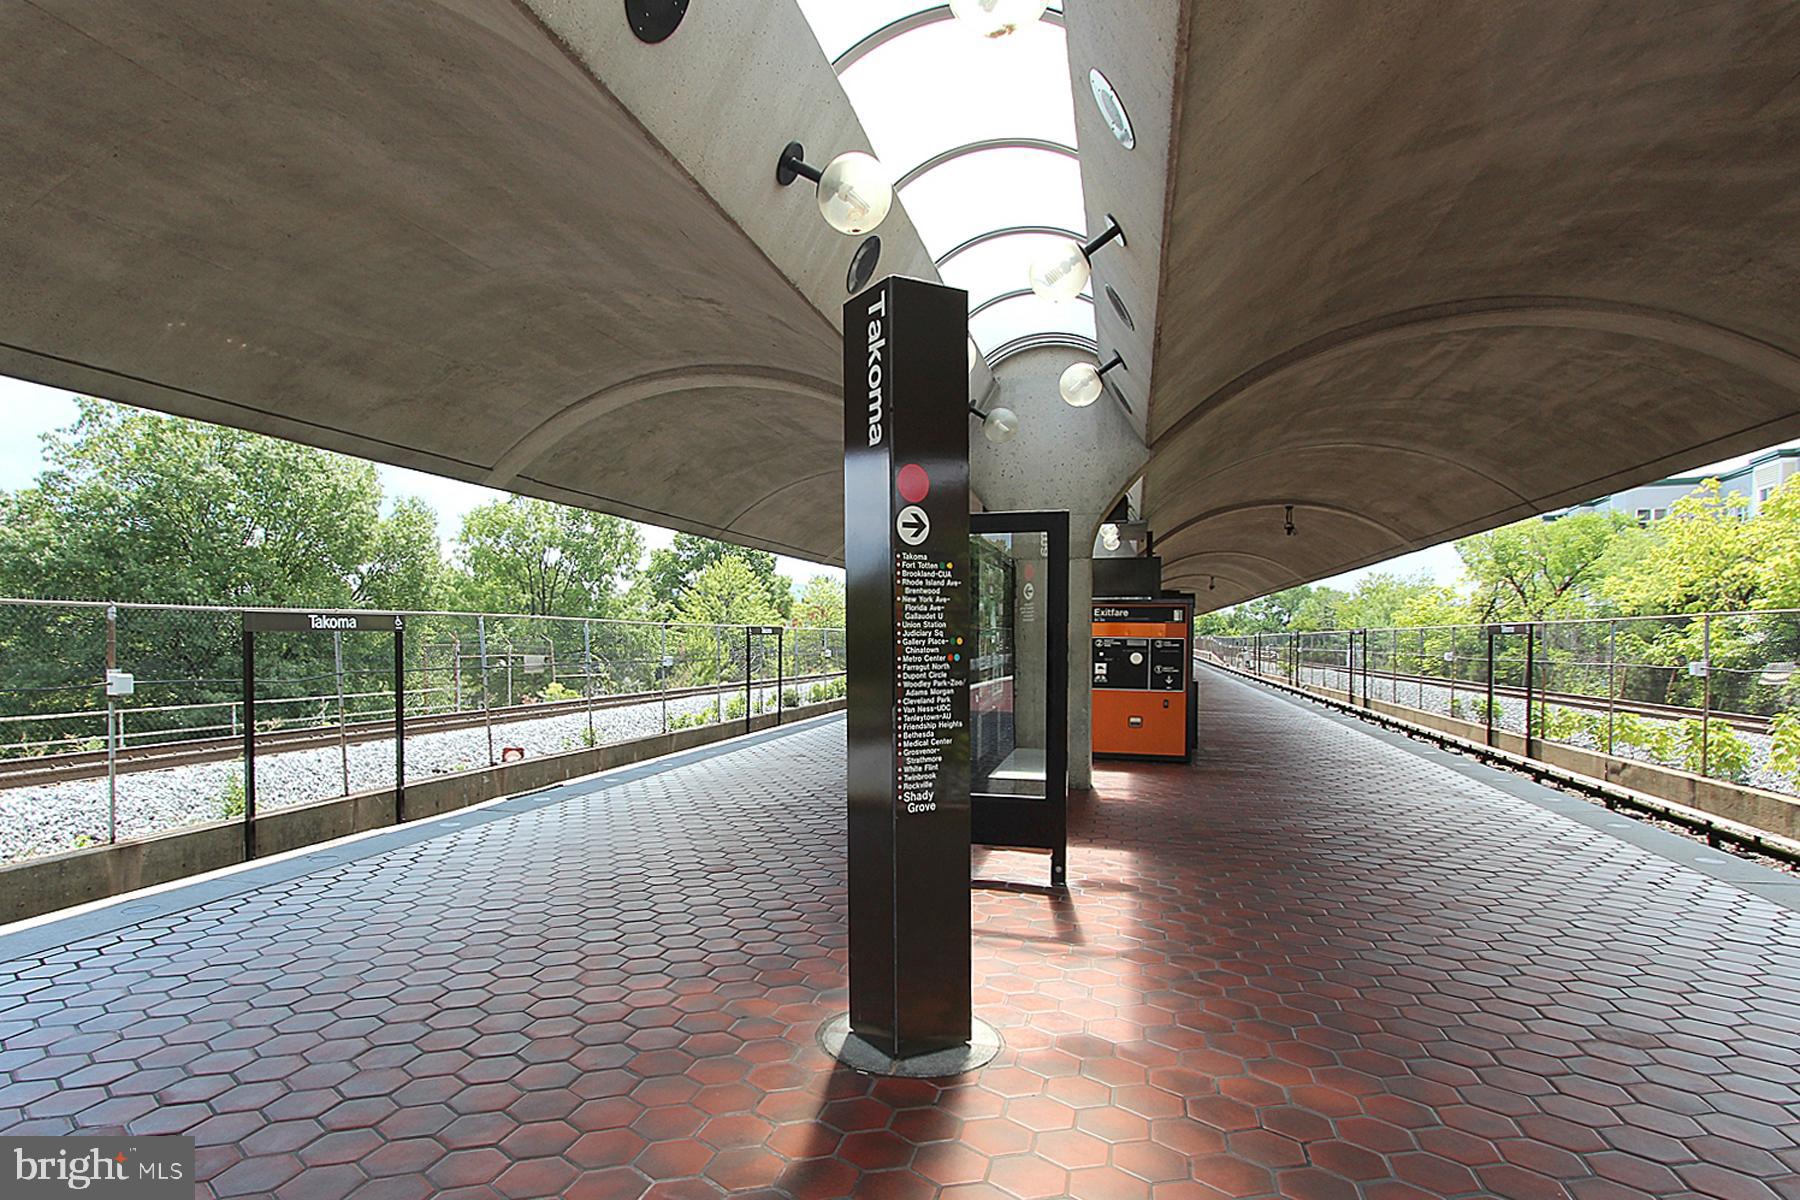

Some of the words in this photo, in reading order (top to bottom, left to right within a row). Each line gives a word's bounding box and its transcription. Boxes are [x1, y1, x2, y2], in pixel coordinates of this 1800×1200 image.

[868, 290, 886, 447] Takoma
[902, 552, 928, 560] Takoma
[902, 561, 915, 569] Fort
[902, 570, 952, 578] Brookland-CUA
[904, 587, 941, 595] Brentwood
[902, 595, 917, 603] New
[904, 612, 936, 620] Gallaudet
[937, 612, 944, 620] U
[1093, 608, 1130, 617] Exitfare
[308, 614, 357, 629] Takoma
[902, 629, 932, 637] Judiciary
[934, 629, 944, 638] Sq
[902, 638, 926, 646] Gallery
[905, 646, 940, 654] Chinatown
[902, 663, 930, 672] Farragut
[902, 672, 927, 680] Dupont
[930, 688, 955, 696] Morgan
[902, 697, 935, 705] Cleveland
[917, 704, 951, 712] Ness-UDC
[903, 712, 952, 722] Tenleytown-AU
[903, 722, 937, 730] Friendship
[938, 720, 963, 729] Heights
[903, 730, 934, 739] Bethesda
[903, 739, 929, 747] Medical
[930, 738, 953, 746] Center
[906, 756, 942, 764] Strathmore
[903, 765, 922, 773] White
[924, 763, 939, 771] Flint
[903, 772, 937, 781] Twinbrook
[903, 781, 933, 790] Rockville
[903, 790, 935, 803] Shady
[907, 802, 937, 813] Grove
